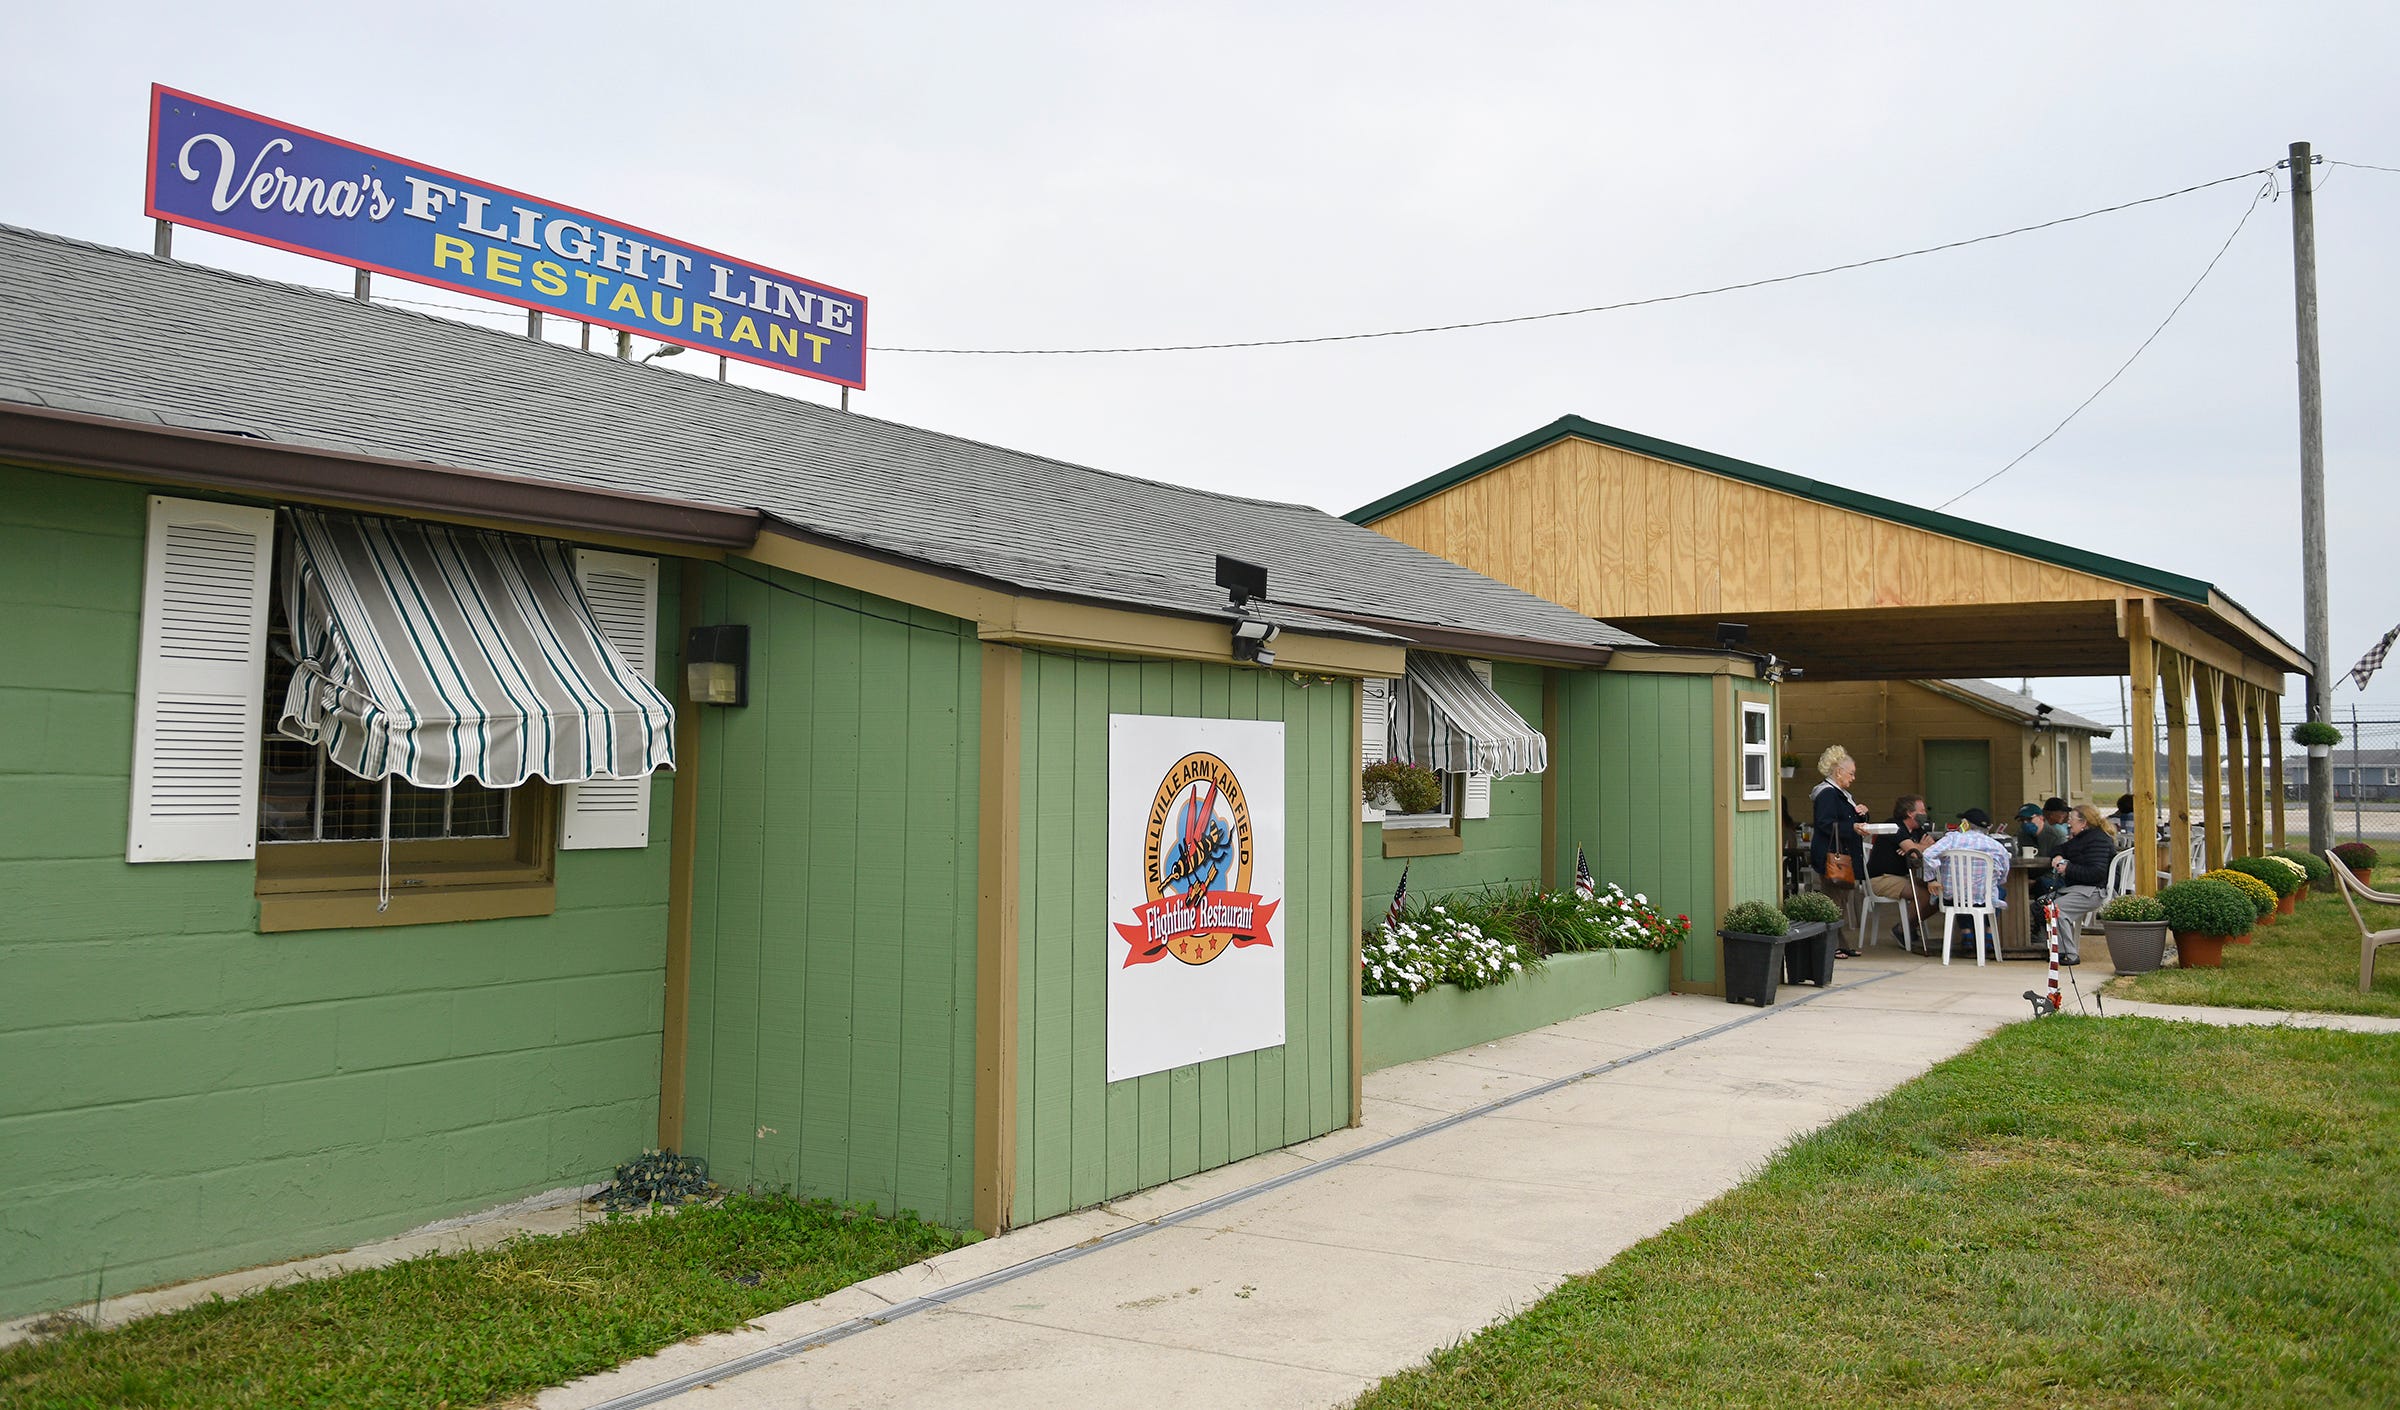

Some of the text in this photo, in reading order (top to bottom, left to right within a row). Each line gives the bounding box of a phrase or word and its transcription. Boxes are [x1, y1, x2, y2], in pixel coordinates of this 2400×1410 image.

[178, 133, 853, 335] Verna's FLIGHT LINE
[433, 233, 831, 364] RESTAURANT
[1148, 760, 1249, 882] MILLVILLE ARMY AIR FIELD
[1146, 896, 1253, 945] Flightline Restaurant
